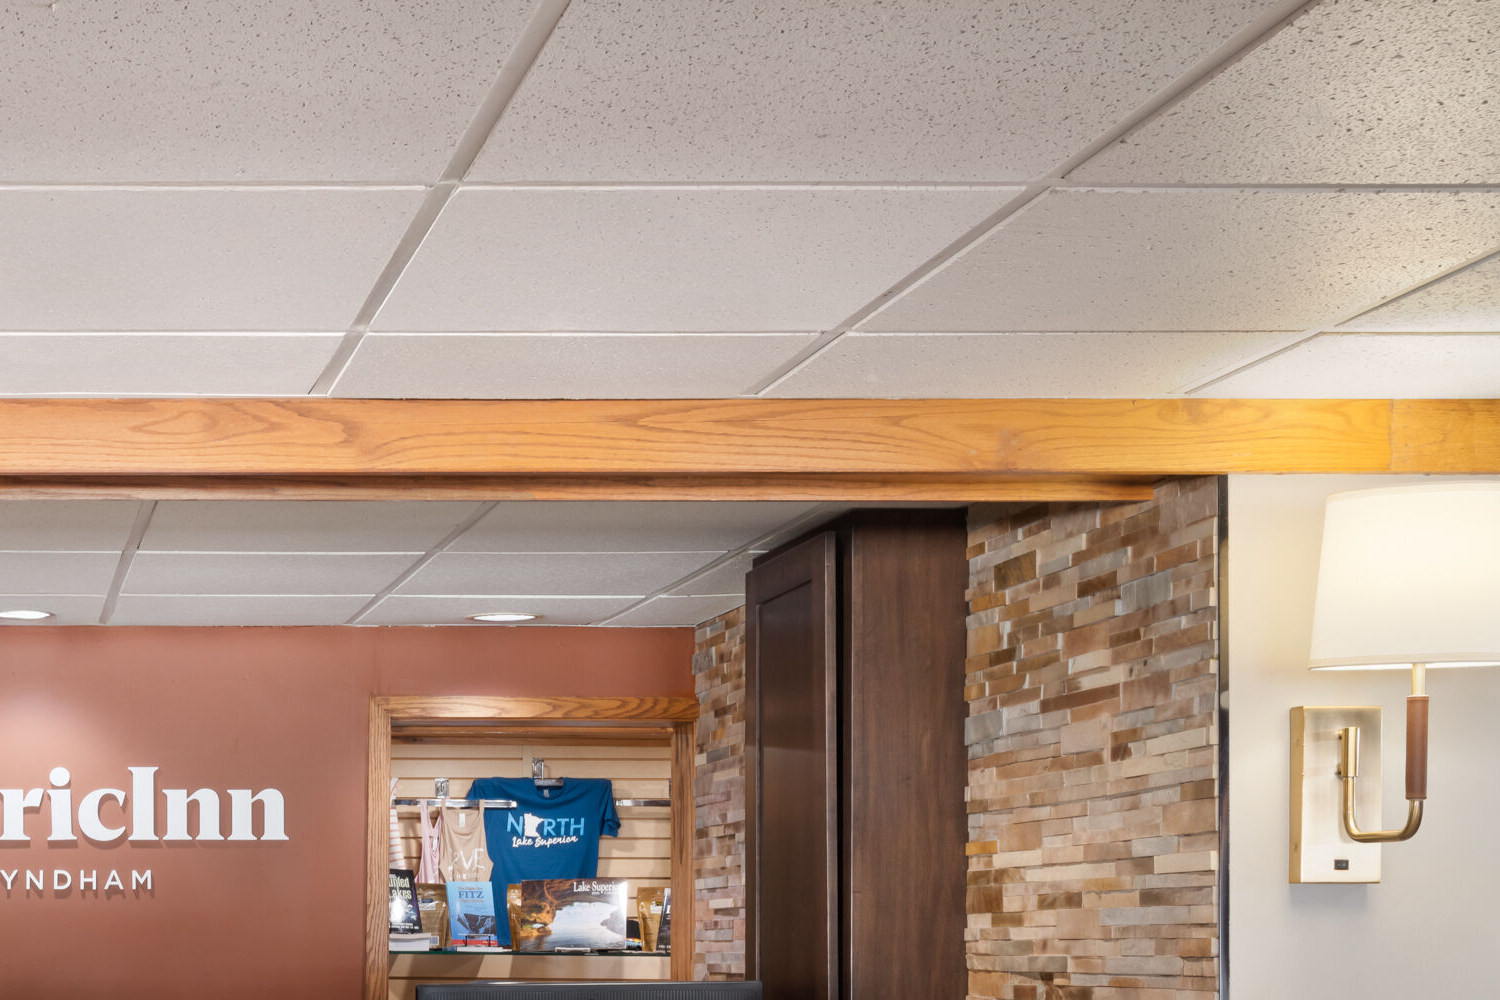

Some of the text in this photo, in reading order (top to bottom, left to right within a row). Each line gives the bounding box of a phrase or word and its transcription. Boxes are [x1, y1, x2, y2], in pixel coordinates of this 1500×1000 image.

[512, 834, 579, 848] Lake Superior
[573, 881, 591, 892] Lake
[458, 890, 484, 899] FITZ
